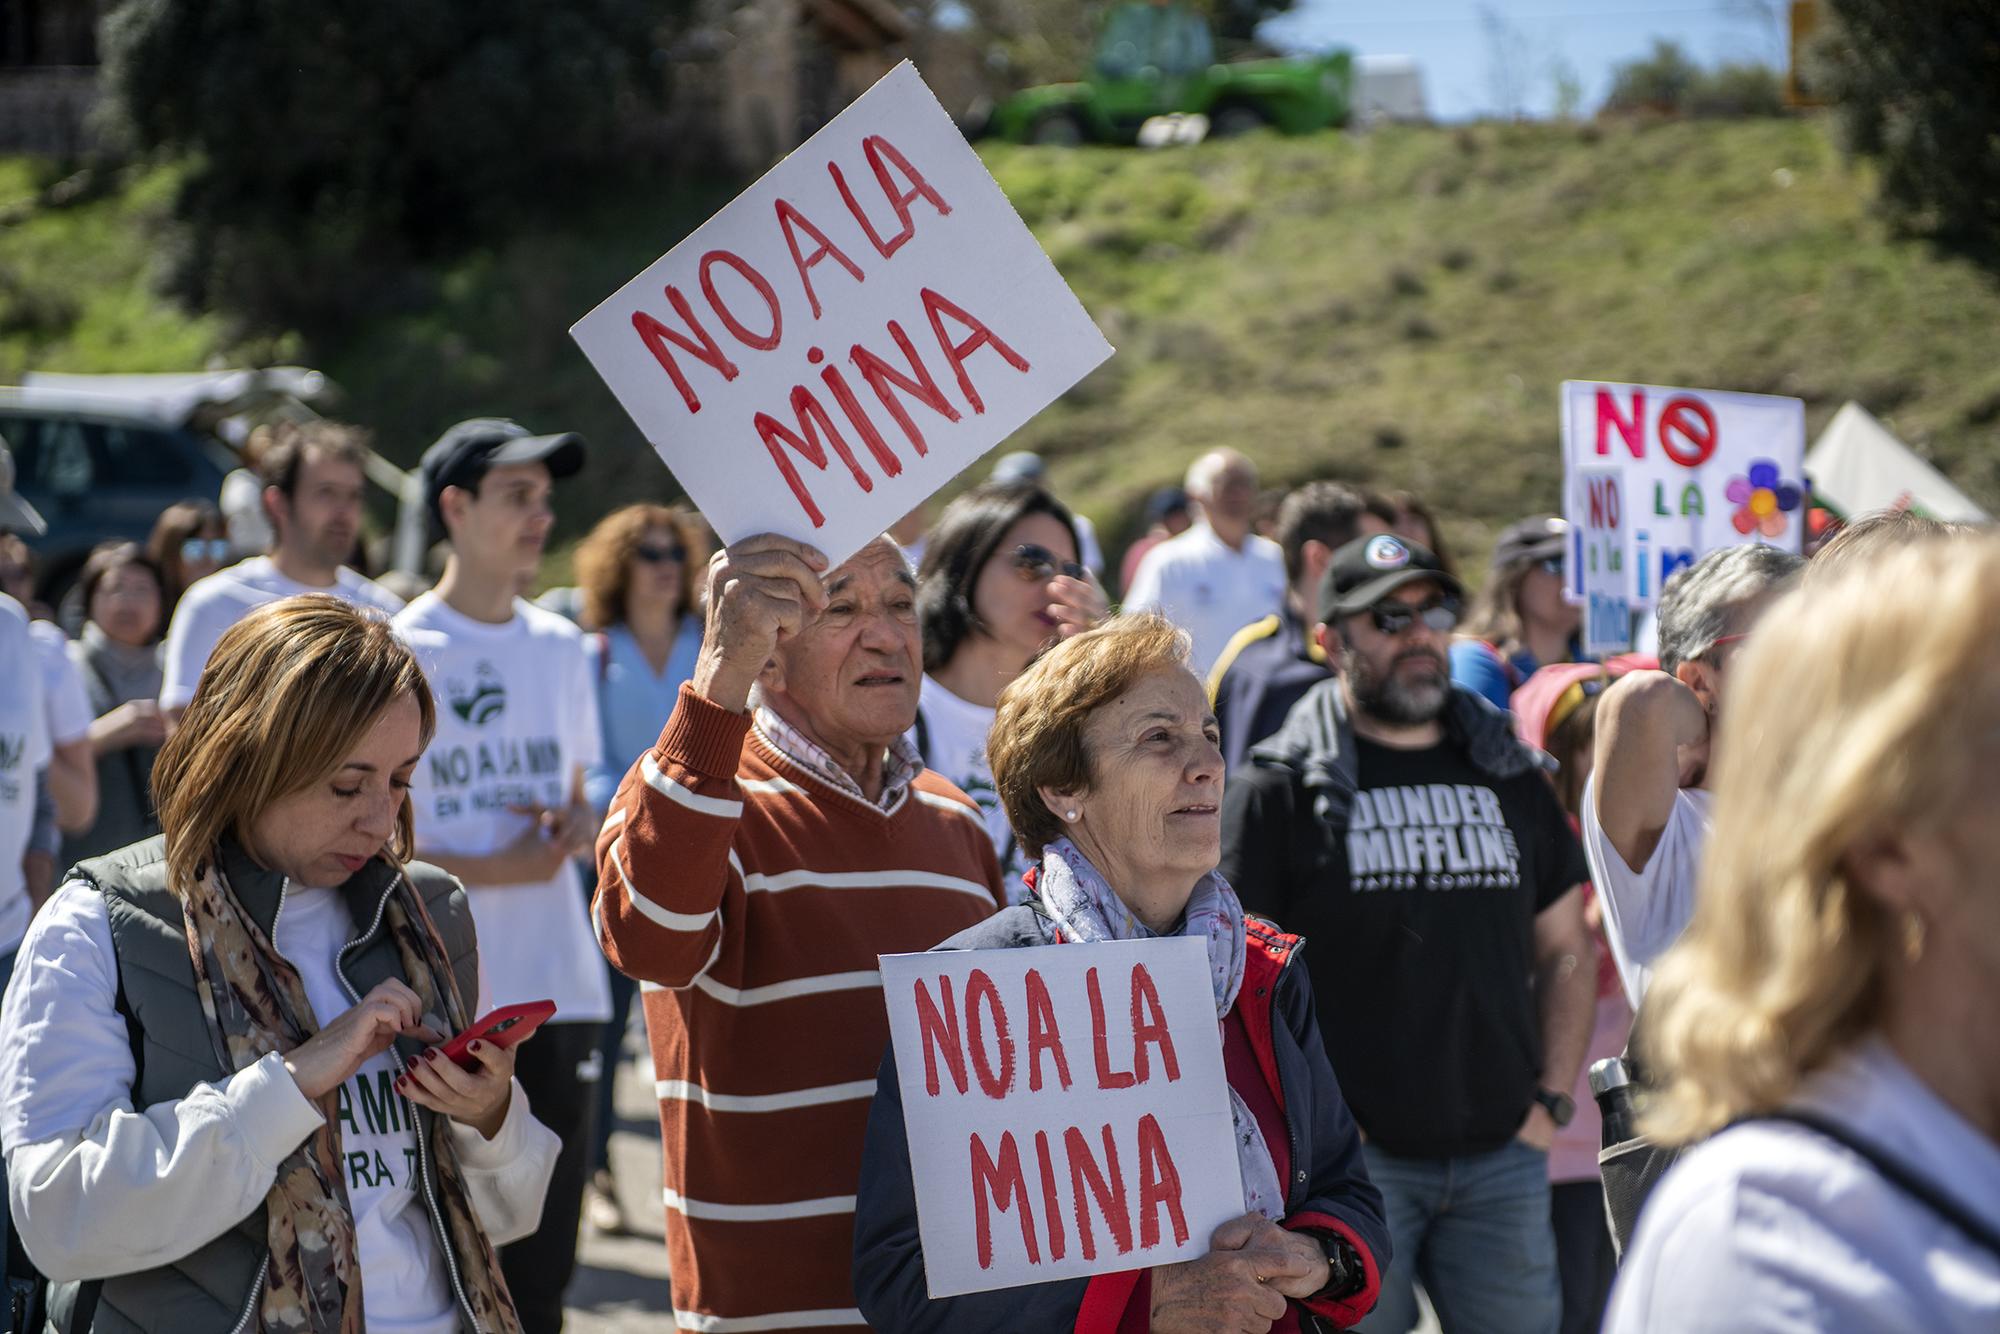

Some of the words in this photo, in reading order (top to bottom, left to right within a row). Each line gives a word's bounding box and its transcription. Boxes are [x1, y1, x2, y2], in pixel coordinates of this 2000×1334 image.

[632, 249, 783, 414] NO
[775, 198, 865, 320] A
[828, 135, 952, 259] LA
[754, 287, 1031, 528] MINA
[1588, 477, 1620, 530] NO
[1654, 480, 1705, 517] LA
[430, 746, 471, 788] NO
[479, 740, 497, 776] A
[1351, 783, 1506, 830] DUNDER
[914, 968, 1016, 1100] NO
[1025, 968, 1073, 1092] A
[1086, 962, 1181, 1090] LA
[970, 1113, 1190, 1270] MINA
